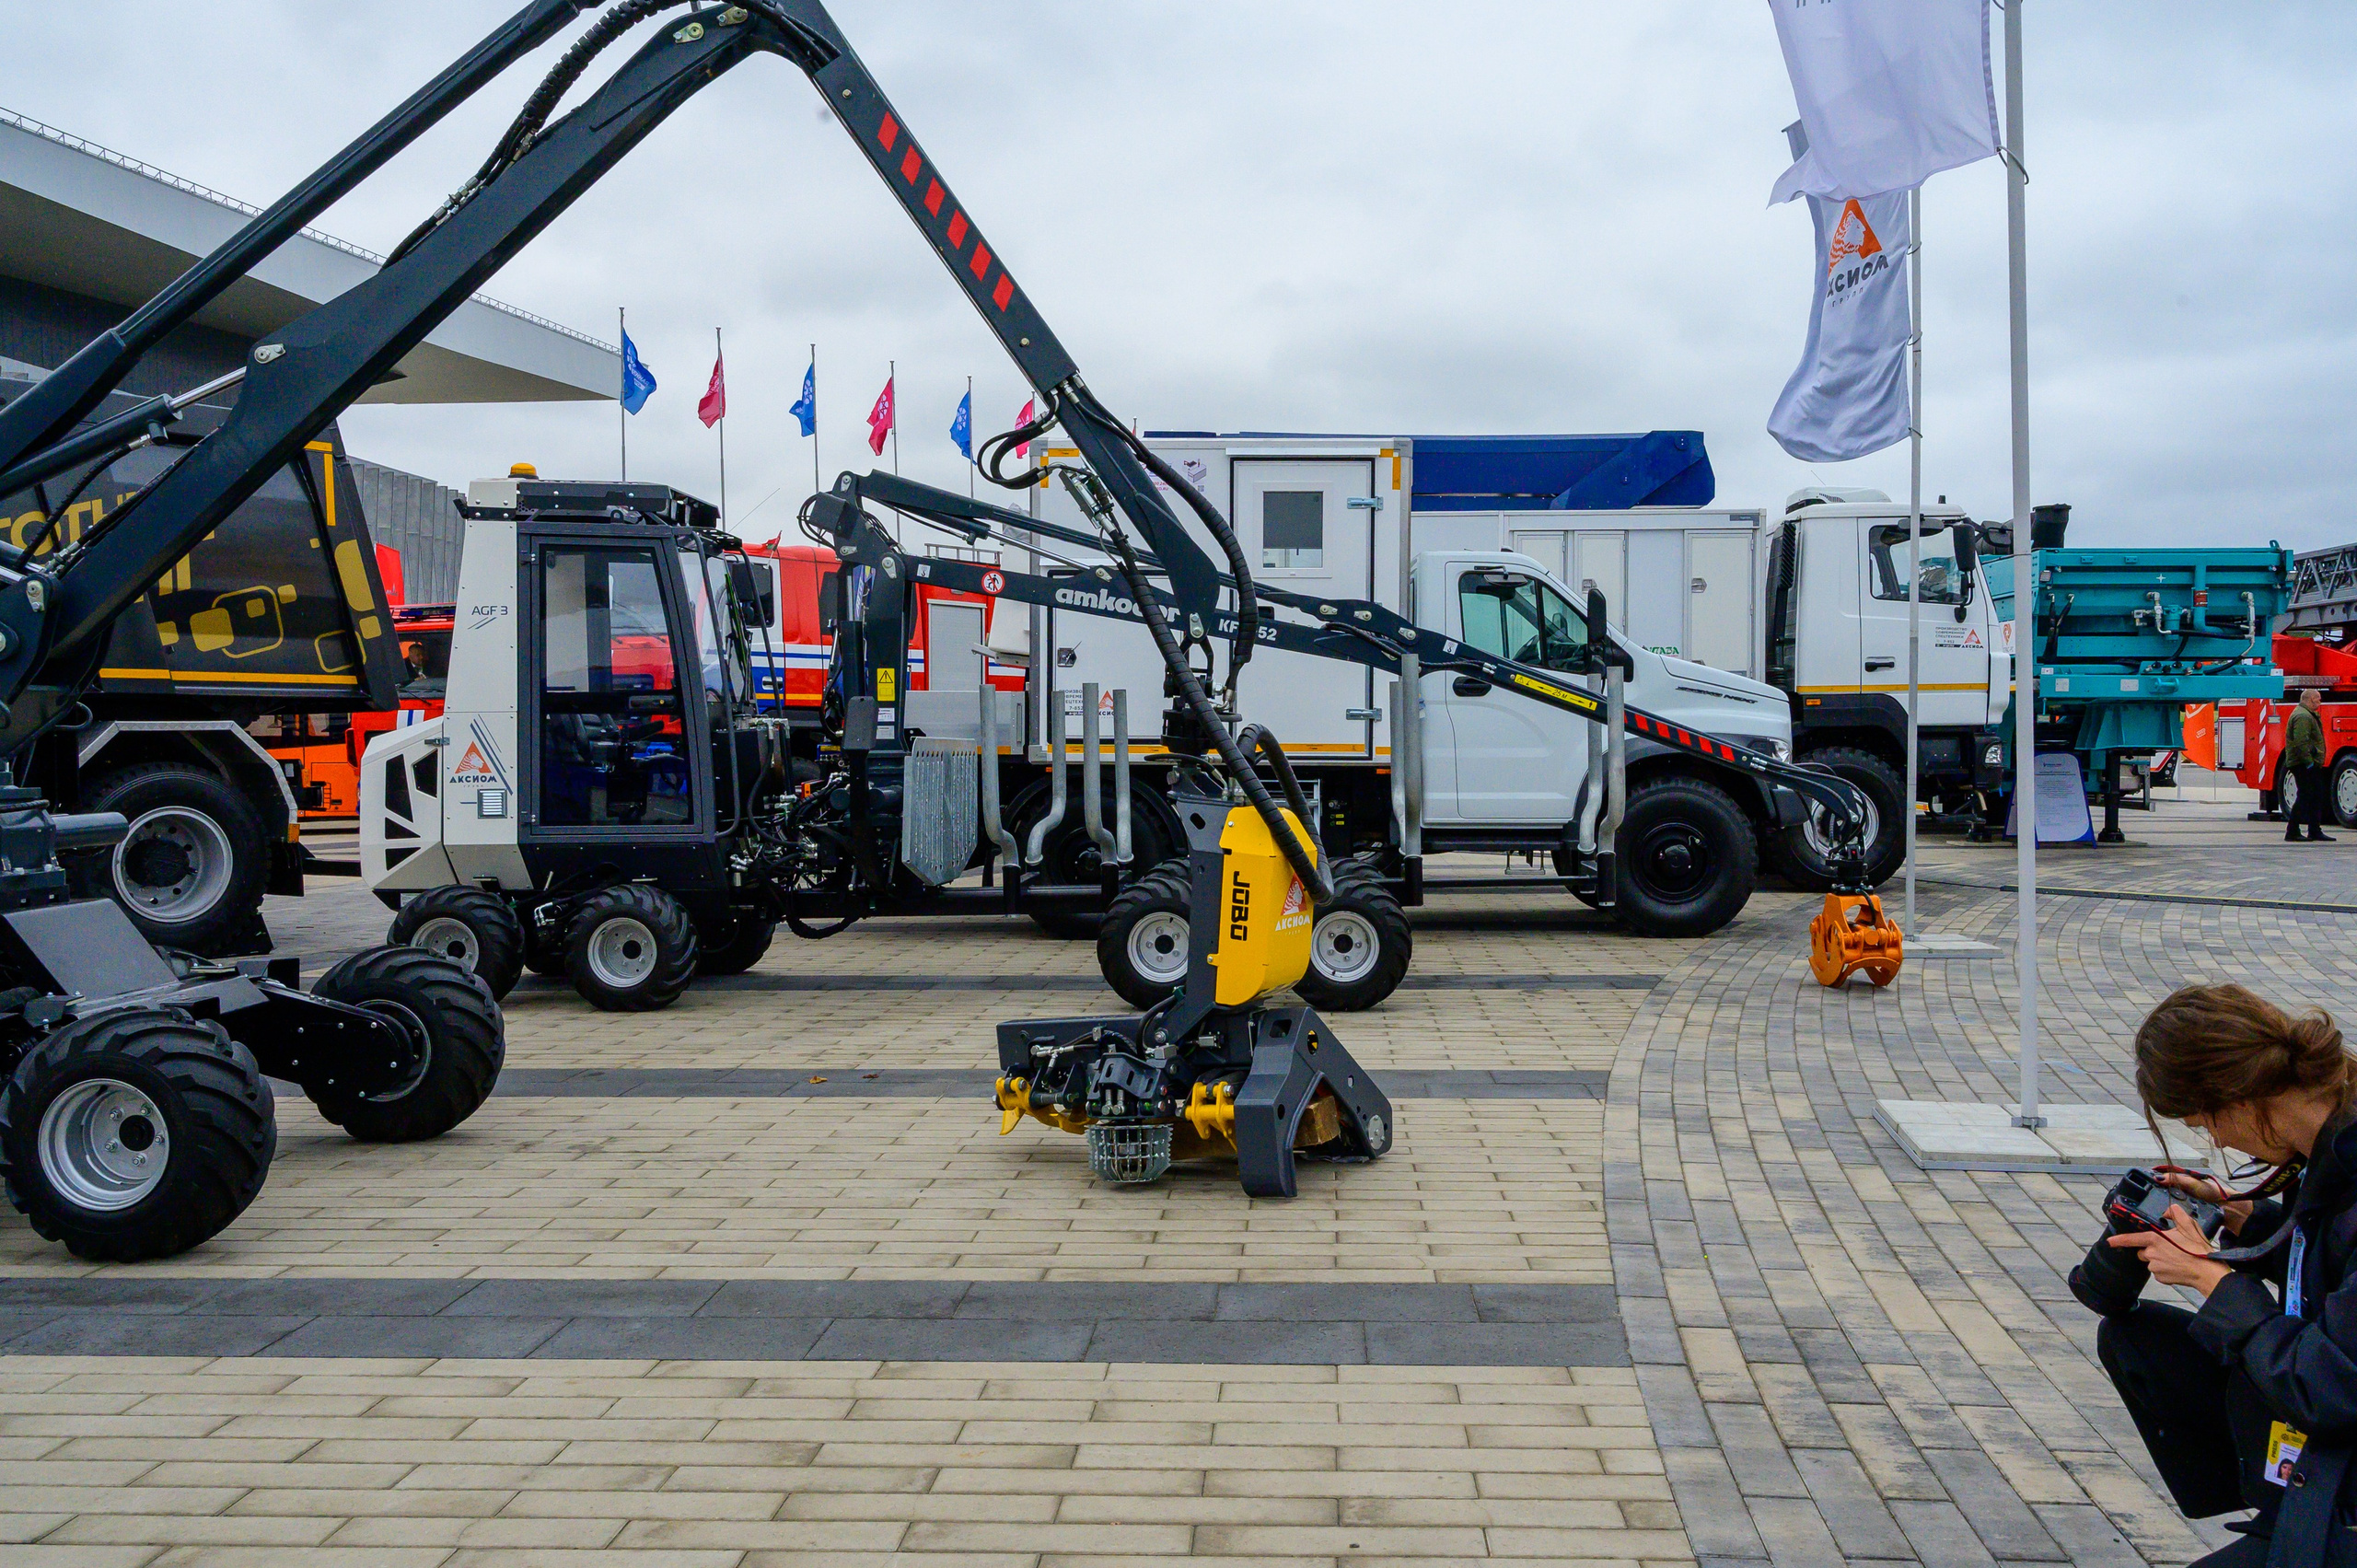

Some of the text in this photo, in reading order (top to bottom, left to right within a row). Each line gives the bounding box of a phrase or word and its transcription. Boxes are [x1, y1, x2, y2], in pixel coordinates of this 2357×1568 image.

[1827, 254, 1889, 297] КСИОМ
[1831, 286, 1864, 307] ГРУПП
[471, 605, 508, 616] AGF 3
[449, 775, 497, 784] АКСИОМ
[1274, 914, 1311, 932] АКСИОМ
[2270, 1440, 2279, 1458] PRESS
